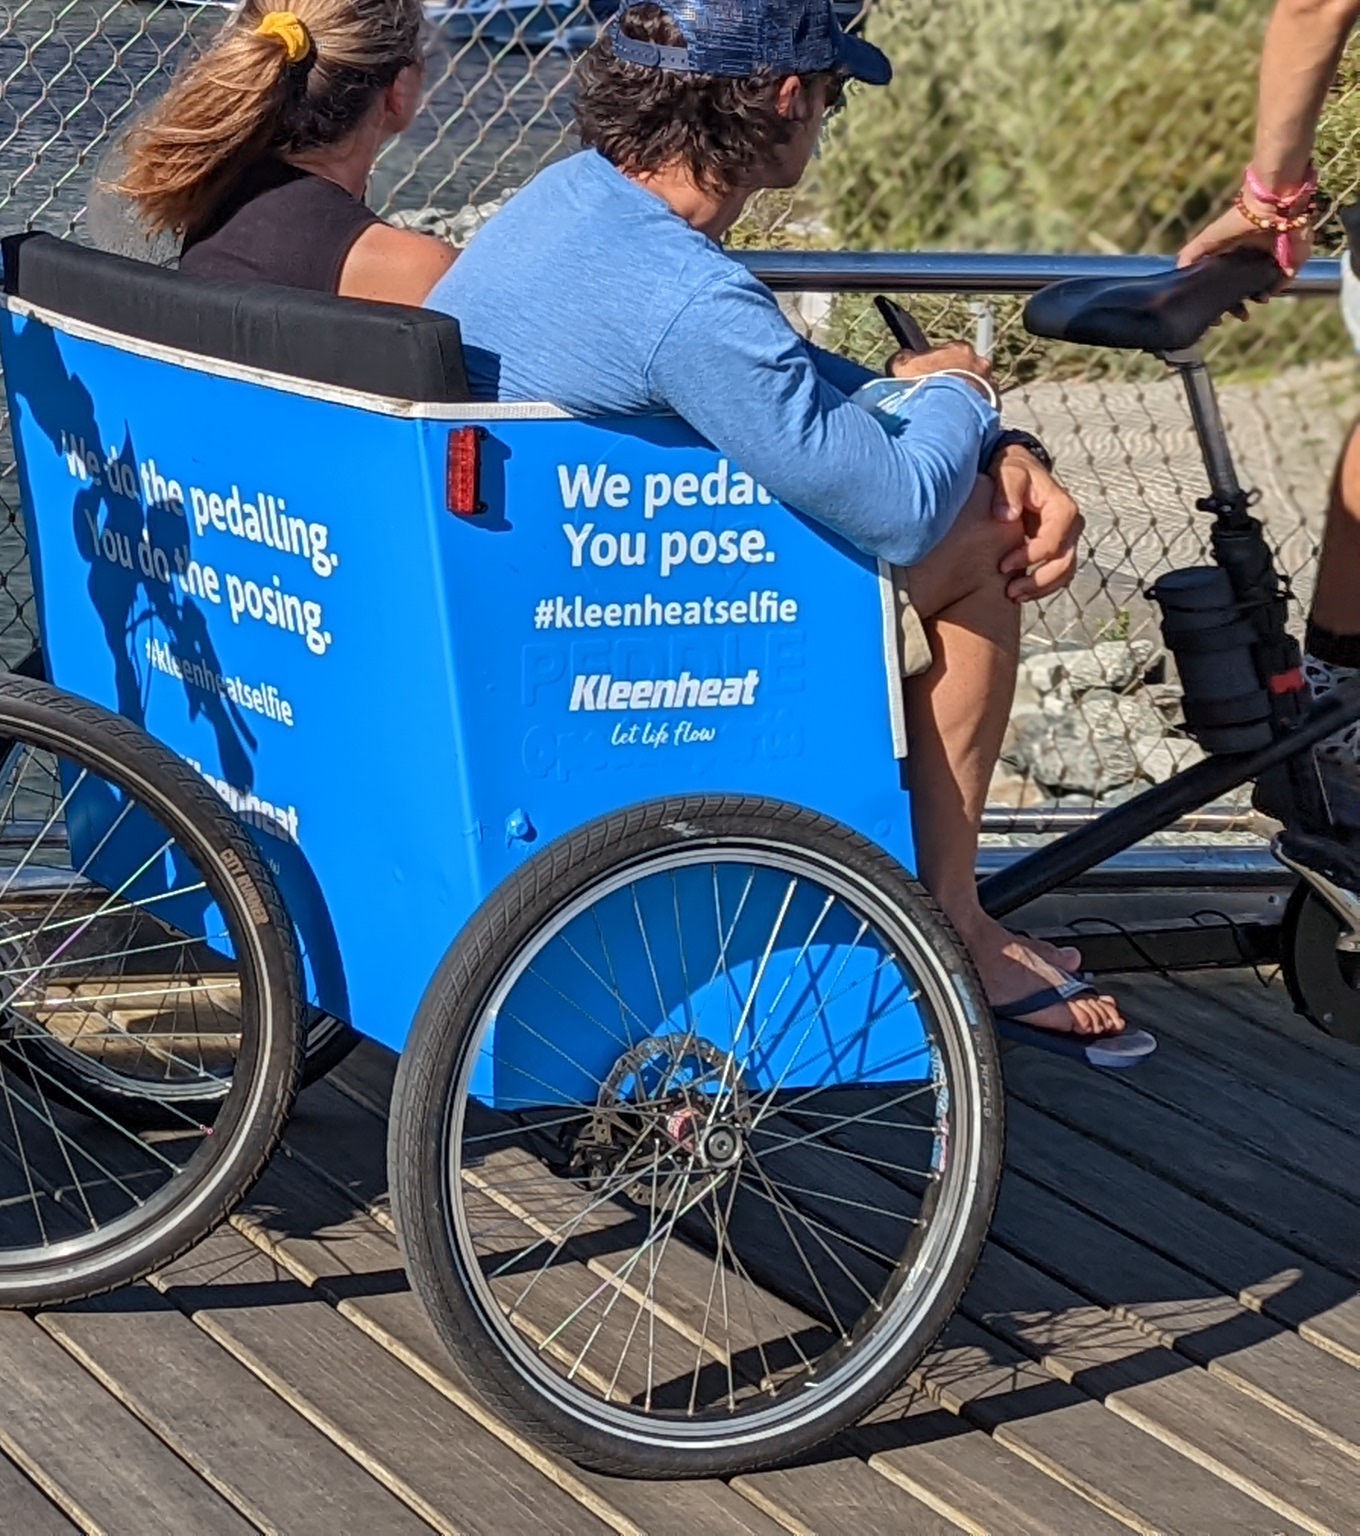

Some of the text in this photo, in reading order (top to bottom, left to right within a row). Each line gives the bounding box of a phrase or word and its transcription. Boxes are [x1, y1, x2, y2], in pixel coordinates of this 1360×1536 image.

[60, 429, 339, 577] We do the pedalling.
[557, 463, 631, 509] We
[561, 522, 775, 577] You pose.
[84, 508, 332, 656] You do the posing.
[533, 590, 798, 629] #kleenheatselfie
[568, 669, 759, 712] Kleenheat
